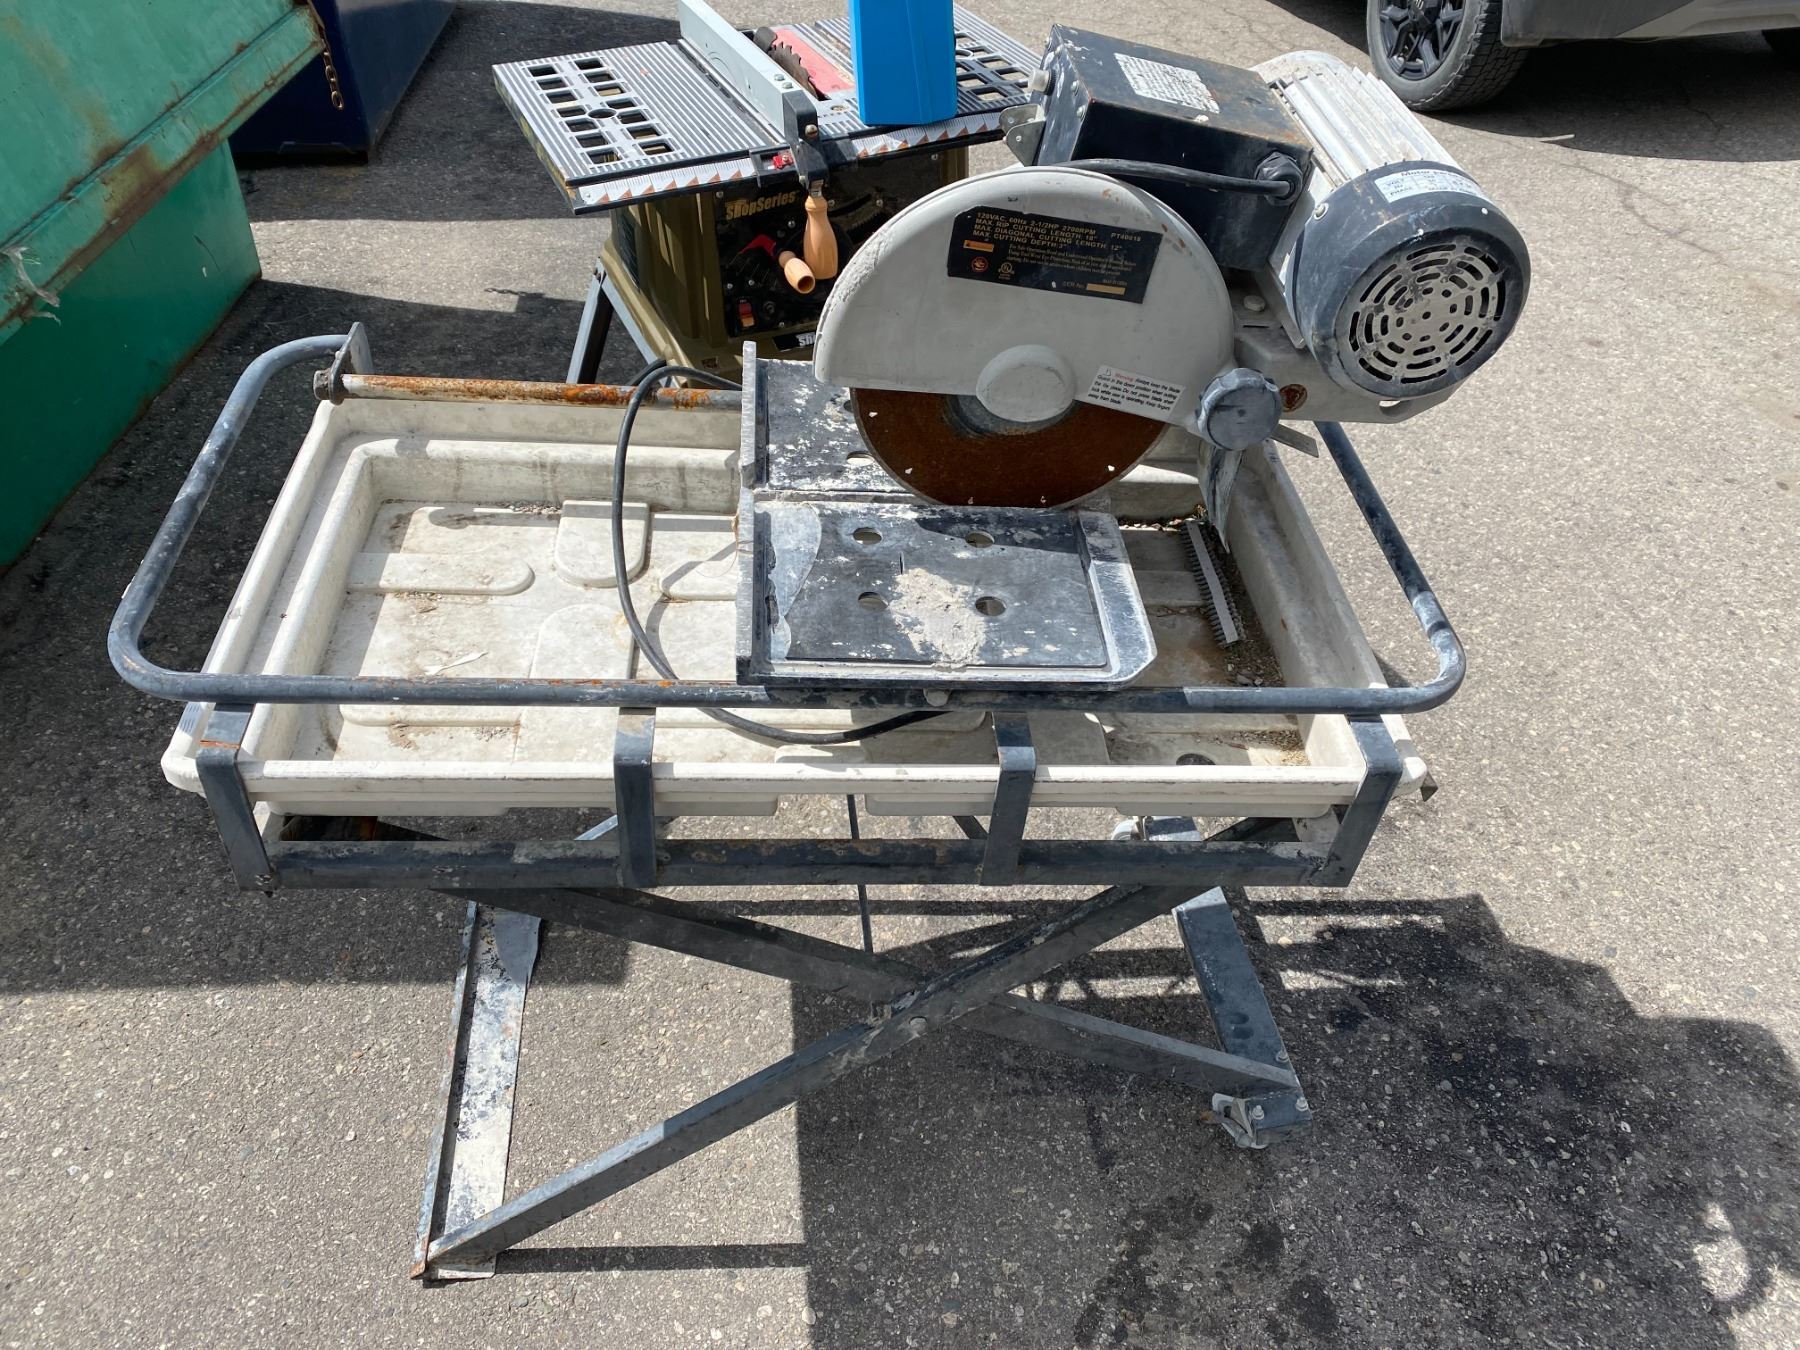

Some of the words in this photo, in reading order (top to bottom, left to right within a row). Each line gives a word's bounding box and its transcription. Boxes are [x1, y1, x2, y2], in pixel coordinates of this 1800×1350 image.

[725, 191, 796, 220] ShopSeries
[1009, 217, 1027, 225] 60Hz
[1030, 220, 1060, 229] 2-1/2HP
[1062, 225, 1096, 235] 2700RPM
[1013, 223, 1047, 234] CUTTING
[994, 233, 1027, 244] CUTTING
[995, 228, 1035, 239] DIAGONAL
[1039, 234, 1072, 244] CUTTING
